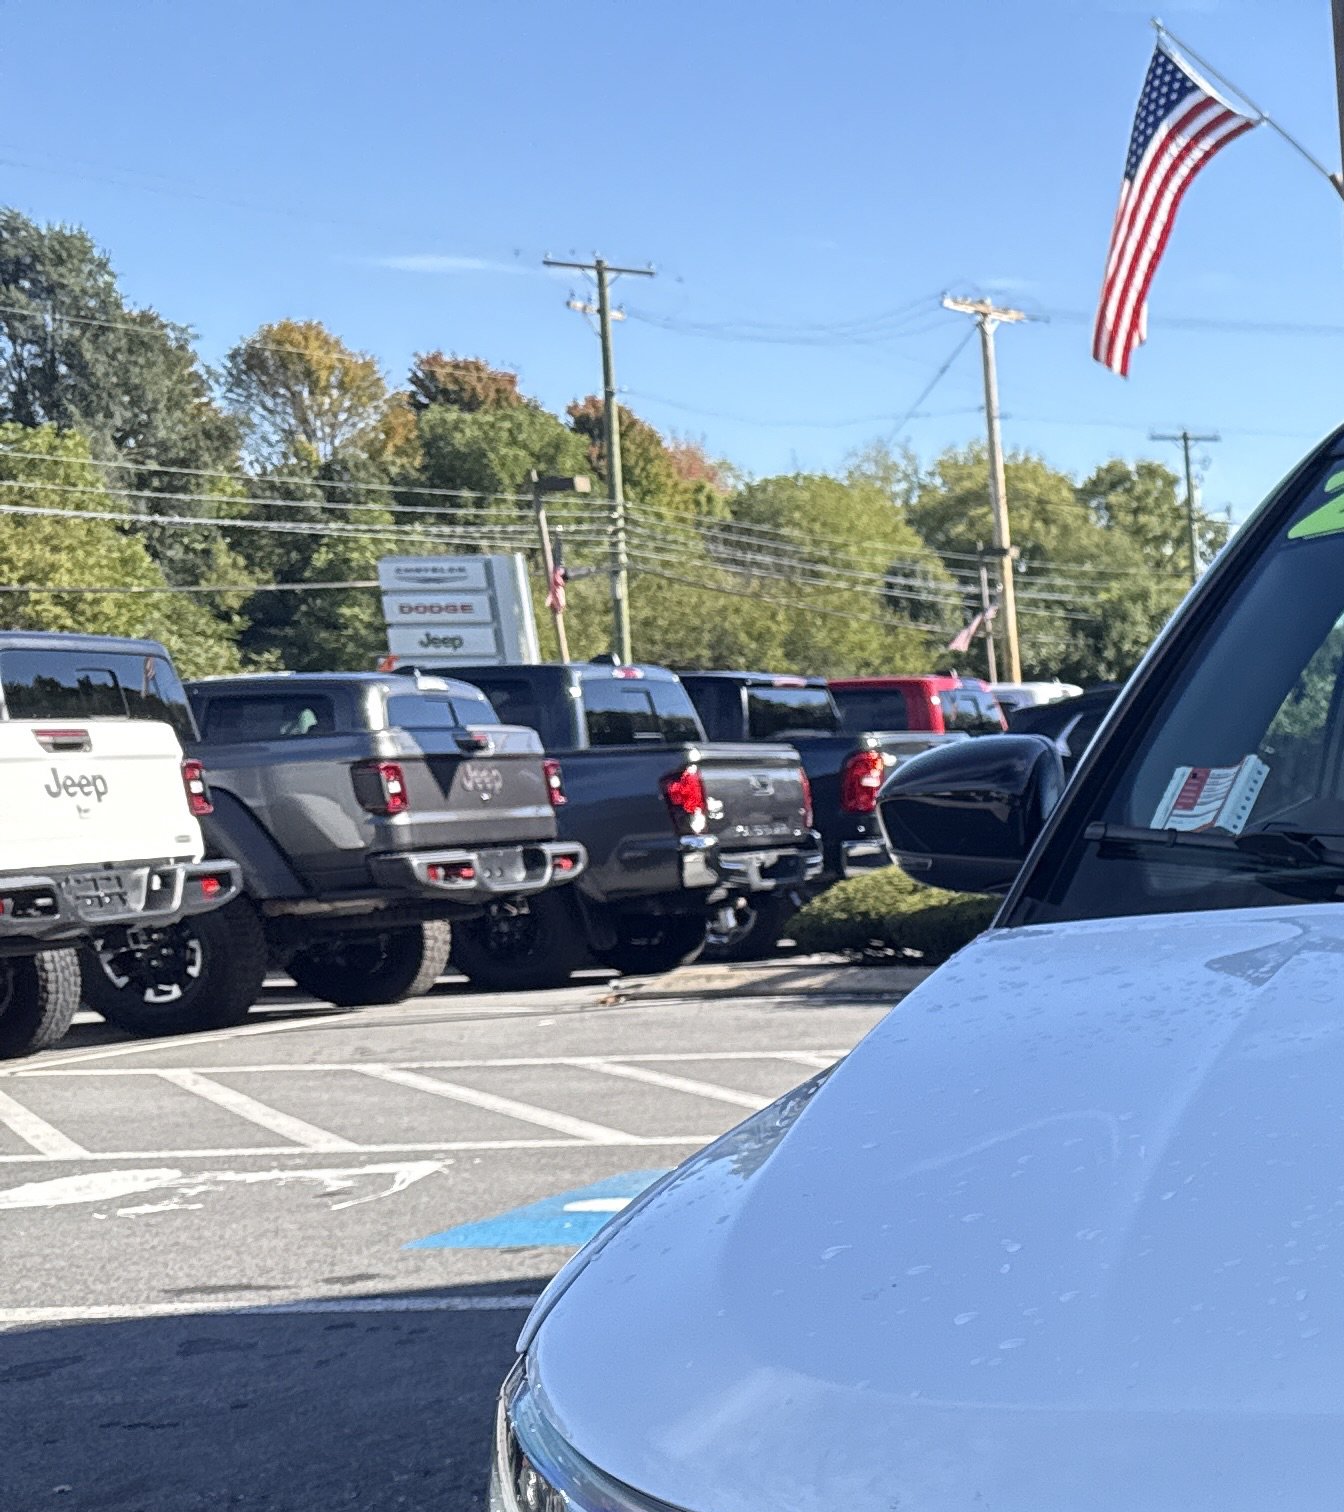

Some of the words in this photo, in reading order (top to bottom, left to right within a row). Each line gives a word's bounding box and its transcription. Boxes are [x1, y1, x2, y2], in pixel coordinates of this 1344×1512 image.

[398, 603, 474, 615] DODGE
[418, 632, 464, 651] Jeep
[44, 767, 109, 802] Jeep
[461, 763, 502, 794] Jeep
